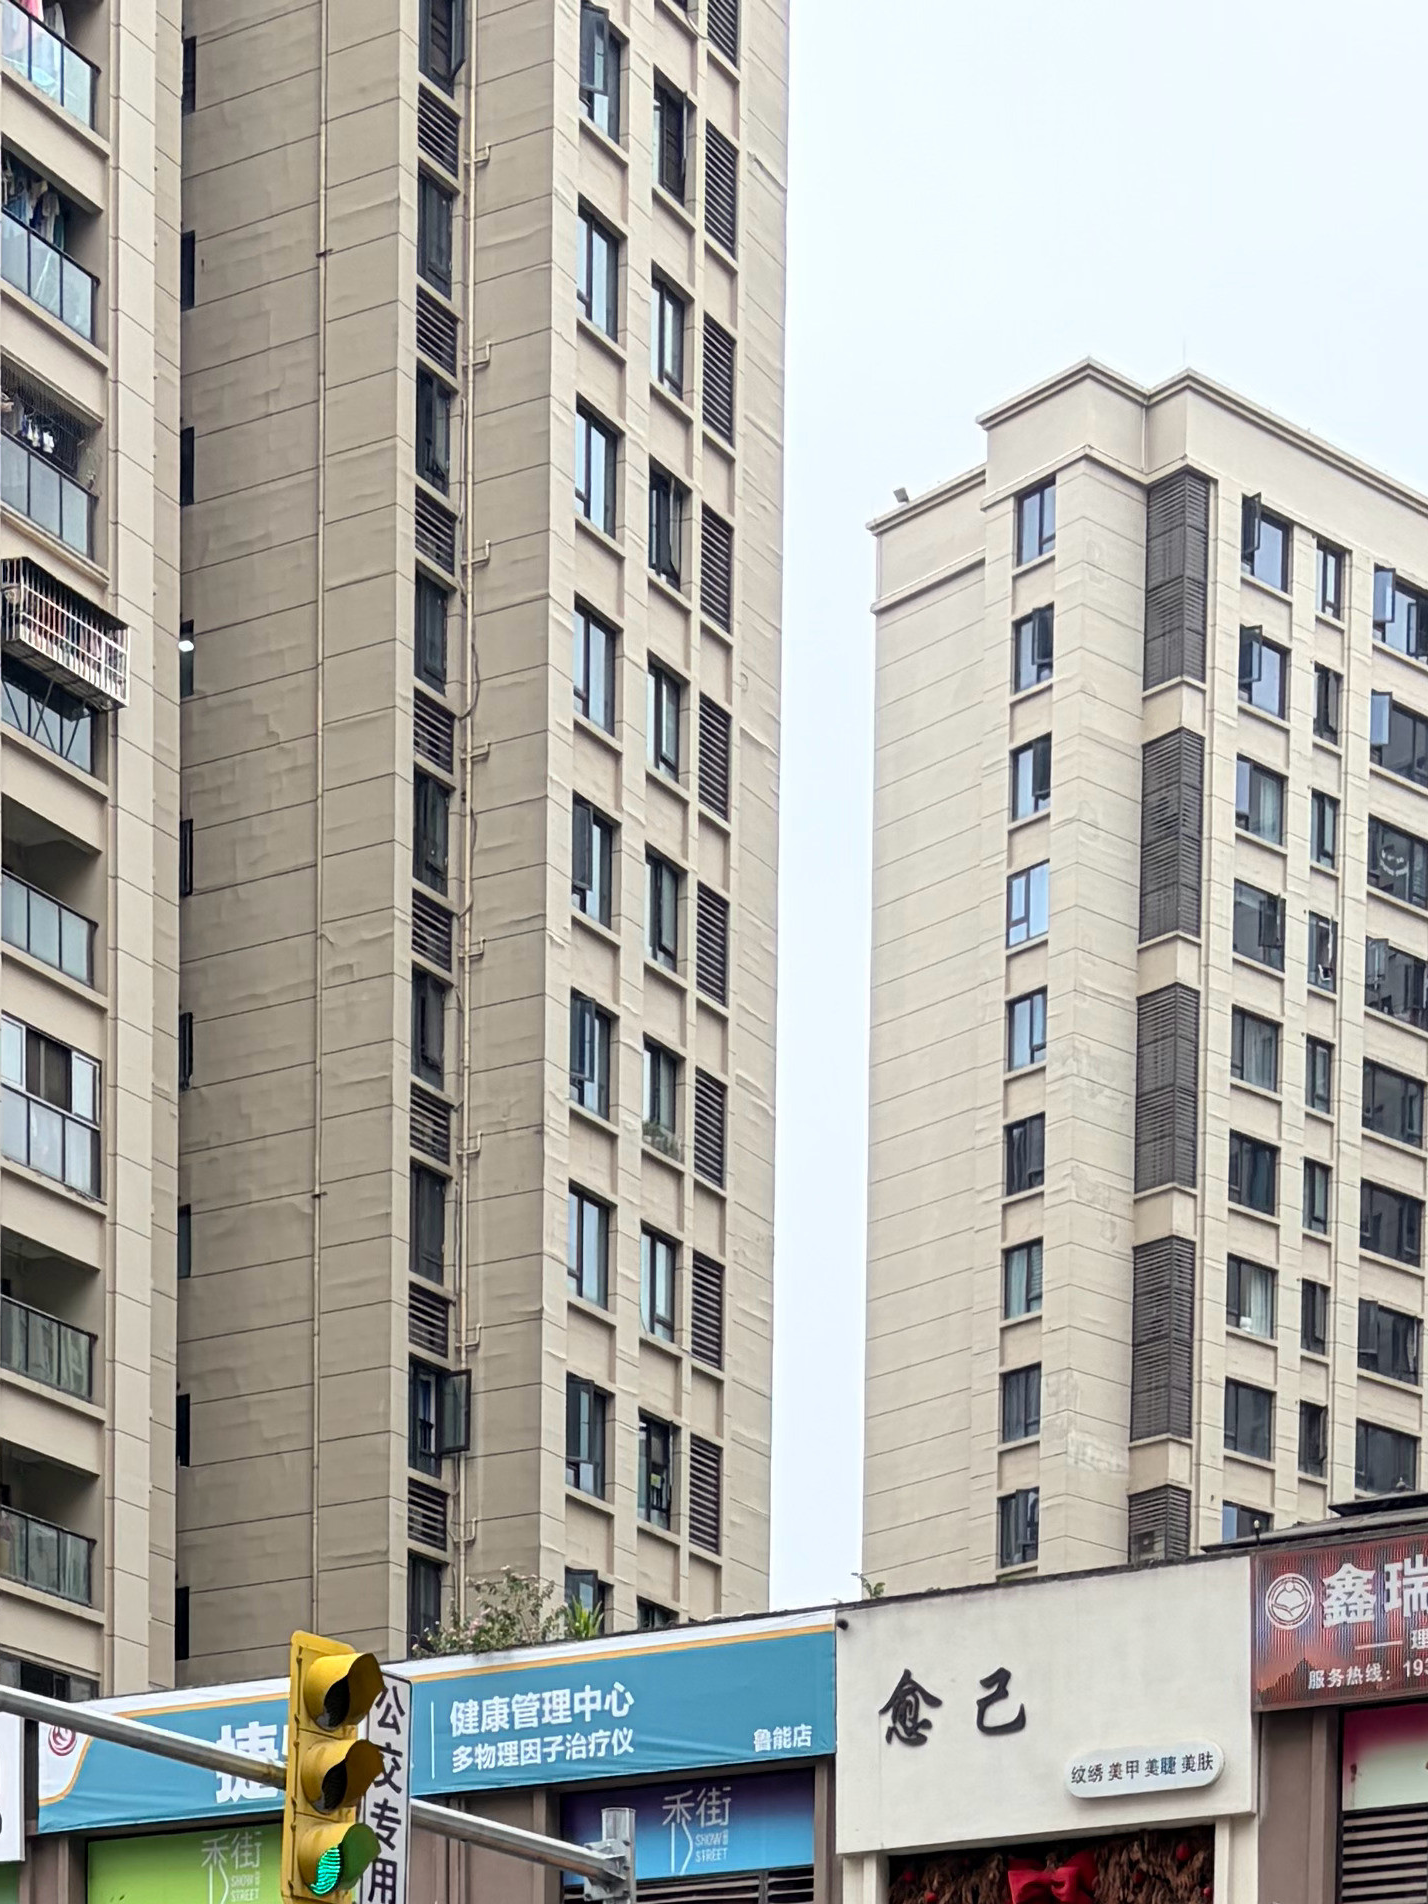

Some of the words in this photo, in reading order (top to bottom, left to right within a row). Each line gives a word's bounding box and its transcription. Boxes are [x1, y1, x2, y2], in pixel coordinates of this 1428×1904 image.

[450, 1681, 635, 1738] 健康管理中心
[451, 1726, 635, 1774] 多物理因子治疗仪
[753, 1723, 813, 1753] 鲁能店
[695, 1849, 728, 1863] STREET
